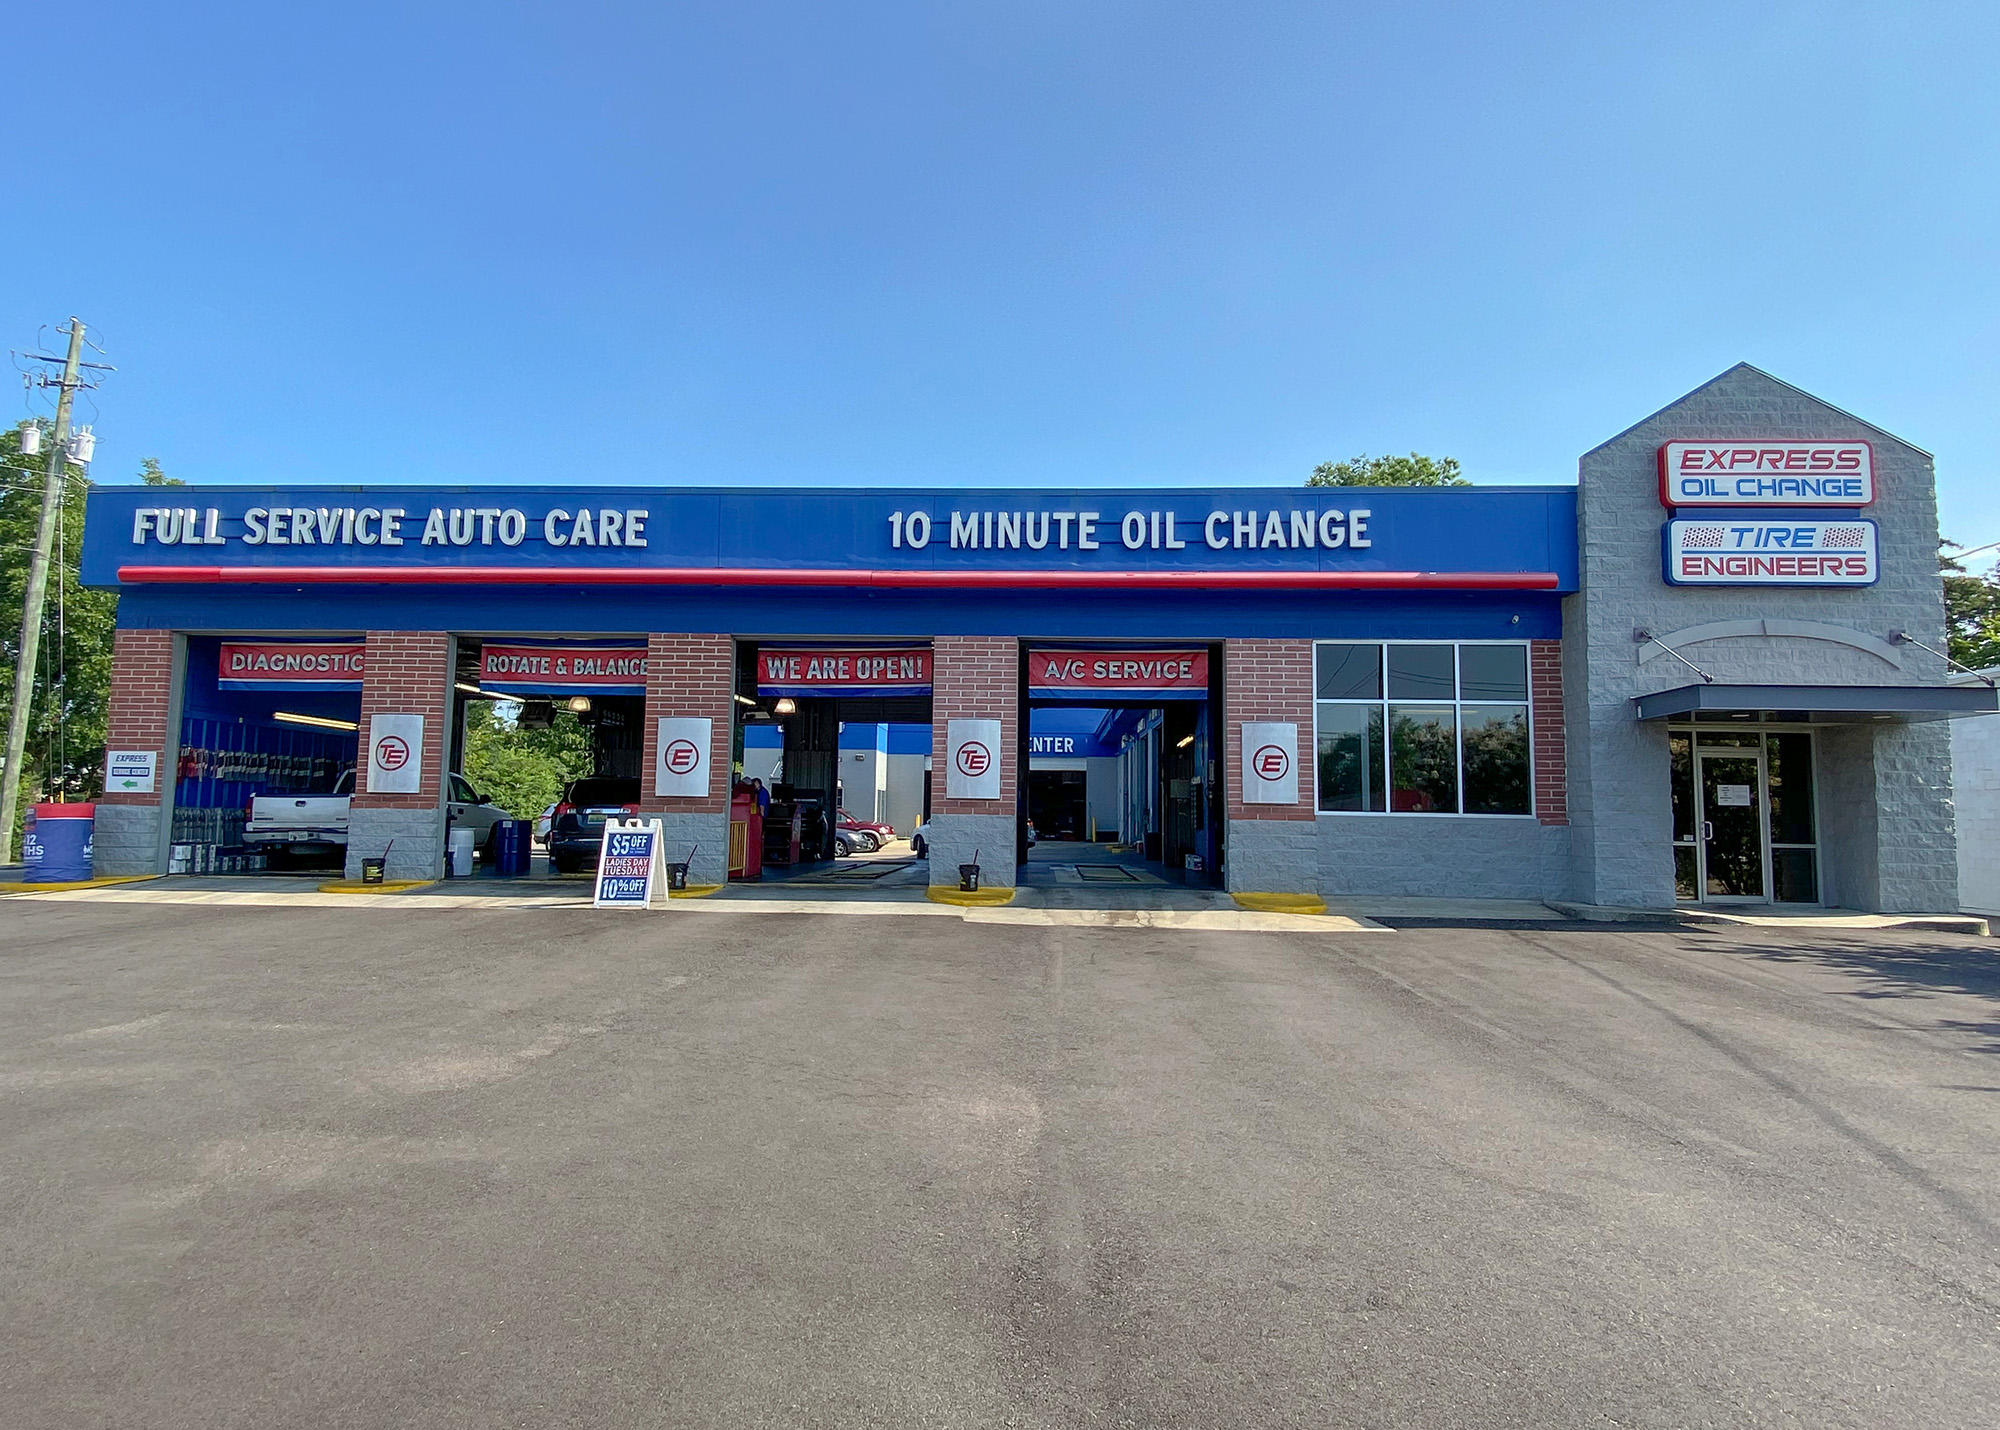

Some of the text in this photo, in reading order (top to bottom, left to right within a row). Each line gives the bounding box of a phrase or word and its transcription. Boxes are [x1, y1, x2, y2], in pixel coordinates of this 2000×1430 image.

[1680, 449, 1862, 470] EXPRESS
[1681, 478, 1863, 497] OIL CHANGE
[132, 508, 649, 547] FULL SERVICE AUTO CARE
[888, 509, 1372, 550] 10 MINUTE OIL CHANGE
[1730, 527, 1817, 548] TIRE
[1681, 557, 1868, 576] ENGINEERS
[231, 653, 364, 672] DIAGNOSTIC
[486, 654, 648, 676] ROTATE & BALANCE
[767, 656, 923, 680] WE ARE OPEN!
[1044, 659, 1193, 680] A/C SERVICE
[115, 754, 148, 763] EXPRESS
[611, 834, 631, 856] $5
[631, 835, 648, 847] OFF
[605, 858, 649, 867] LADIES DAY
[605, 866, 648, 876] TUESDAY!
